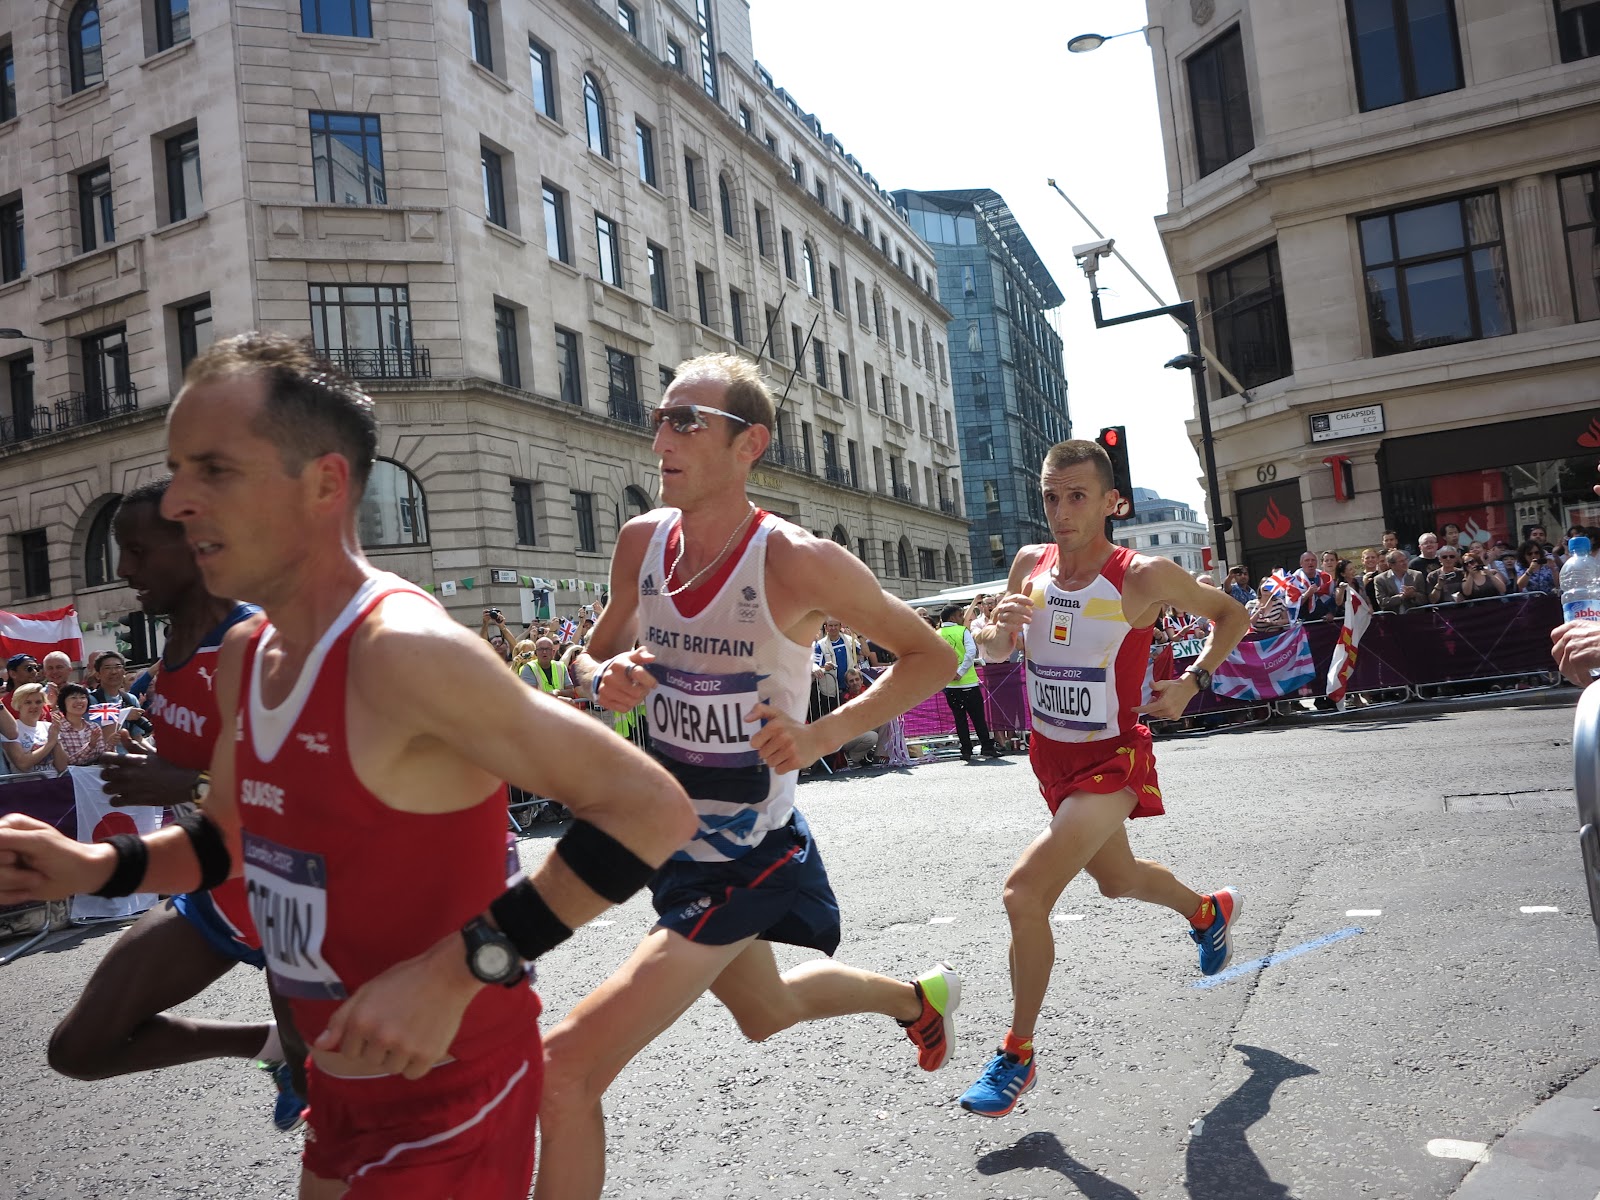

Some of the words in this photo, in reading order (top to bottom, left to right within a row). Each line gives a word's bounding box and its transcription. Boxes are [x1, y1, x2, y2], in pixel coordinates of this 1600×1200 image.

[1336, 409, 1376, 420] CHEAPSIDE
[1363, 416, 1377, 424] EC2
[1257, 464, 1277, 483] 69
[645, 626, 680, 648] REAT
[683, 634, 754, 656] BRITAIN
[1263, 650, 1293, 669] London
[666, 671, 692, 690] London
[693, 680, 721, 691] 2012
[1035, 666, 1061, 678] London
[1062, 669, 1082, 678] 2012
[1034, 680, 1091, 717] CASTILLEJO
[653, 693, 750, 743] OVERALL
